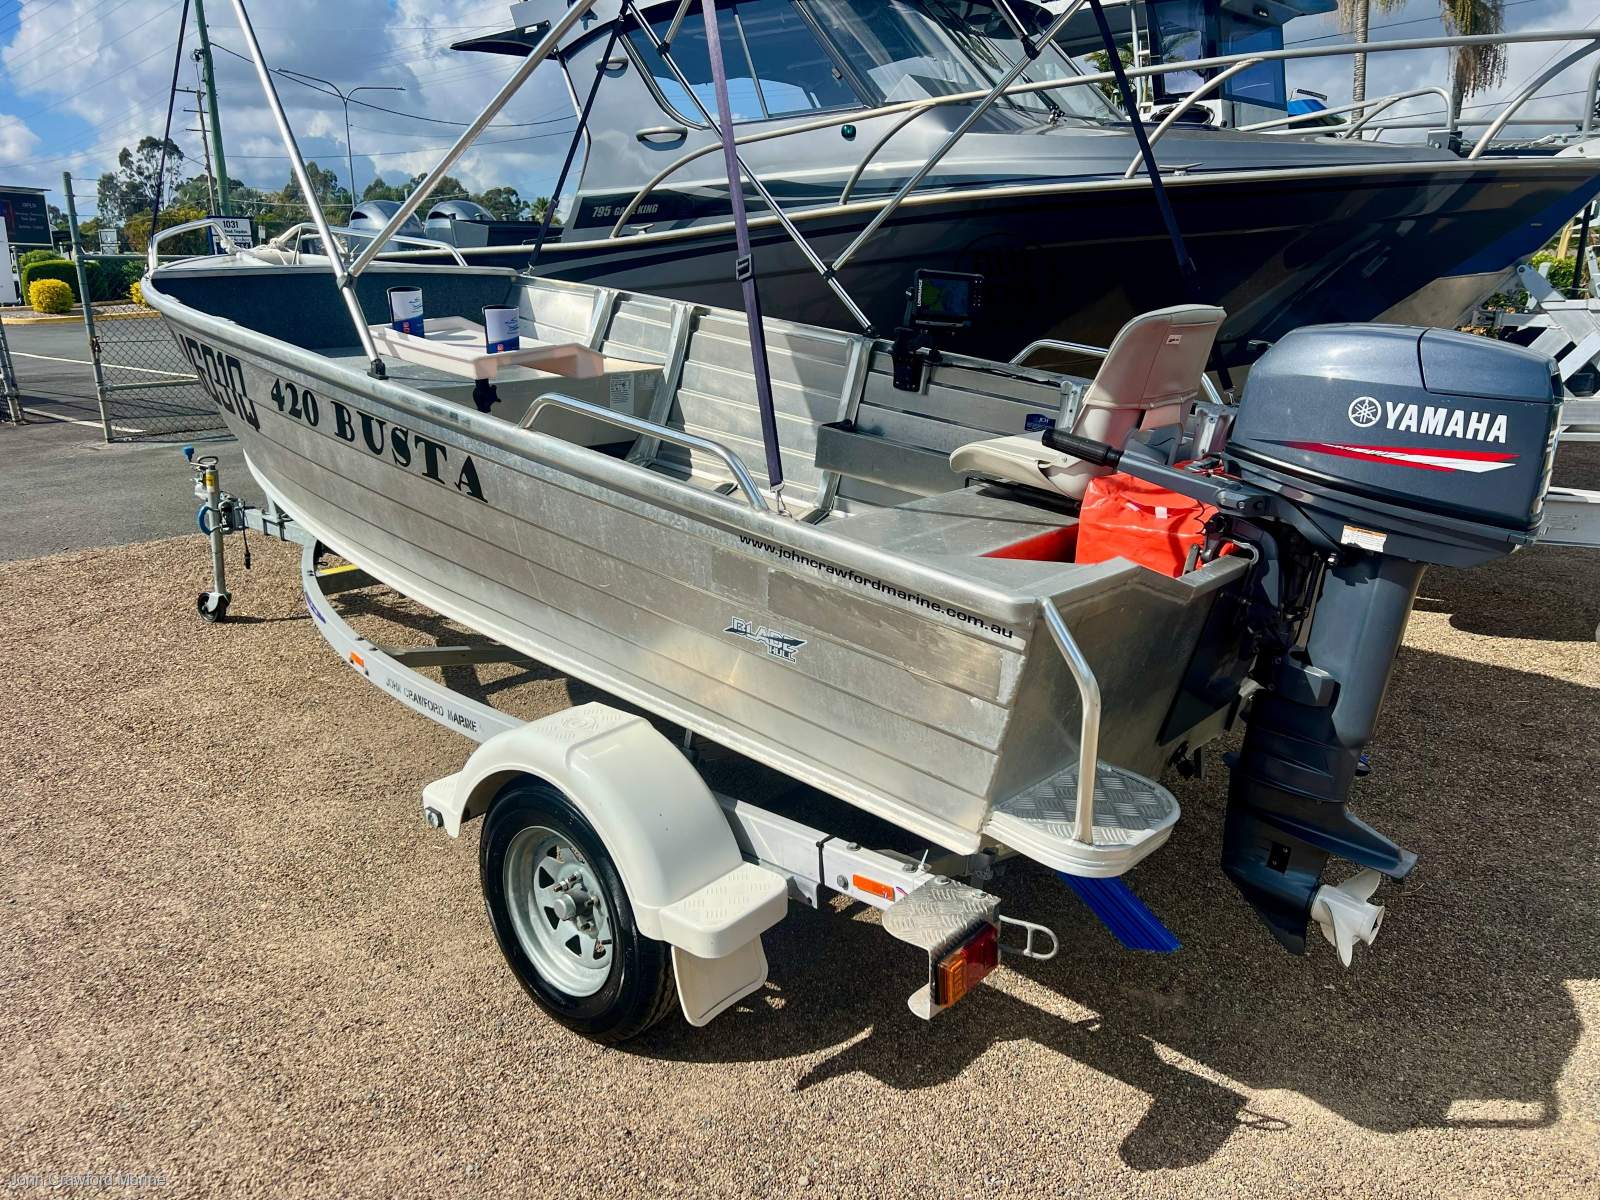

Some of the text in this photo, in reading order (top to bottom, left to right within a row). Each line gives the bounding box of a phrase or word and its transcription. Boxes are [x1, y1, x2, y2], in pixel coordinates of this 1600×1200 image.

[223, 220, 239, 229] 1031
[592, 206, 612, 218] 795
[638, 204, 659, 214] KING
[271, 378, 488, 503] 420 BUSTA
[1386, 401, 1509, 444] YAMAHA
[738, 533, 1014, 640] www.johncrawfordmarine.com.au
[724, 616, 808, 654] BLADE
[403, 687, 445, 717] CRAWFORD
